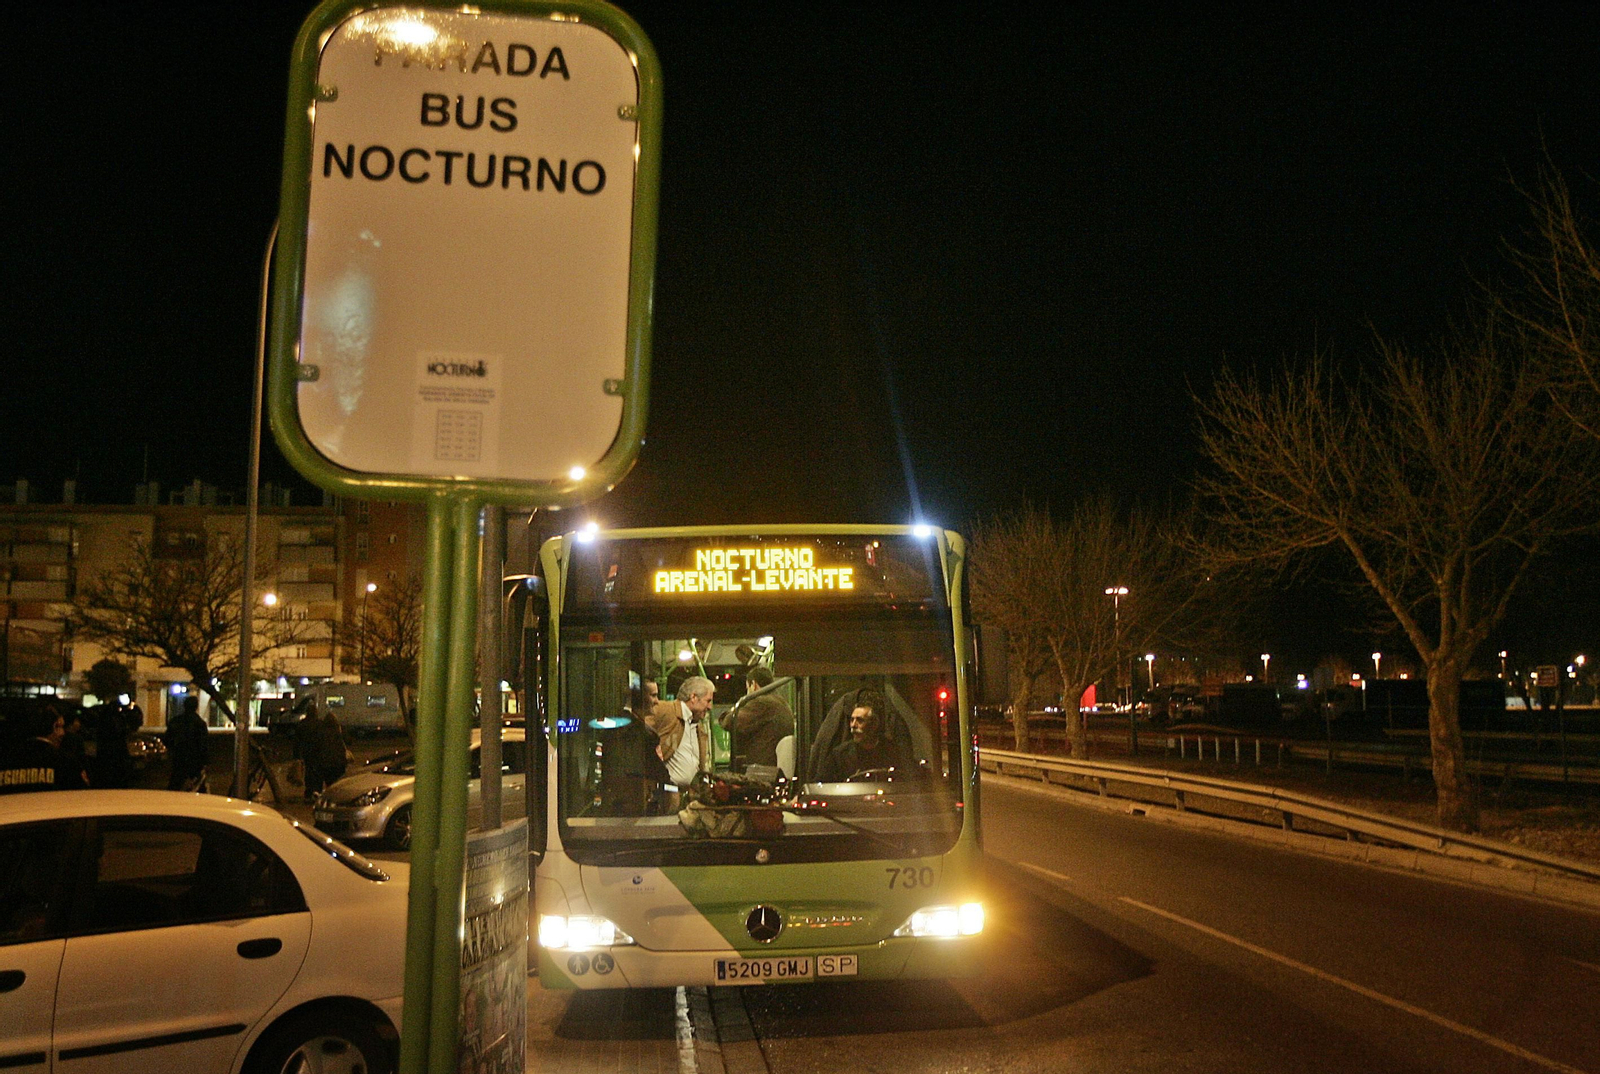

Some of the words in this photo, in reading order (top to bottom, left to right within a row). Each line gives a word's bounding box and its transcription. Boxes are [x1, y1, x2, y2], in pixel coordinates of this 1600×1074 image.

[420, 93, 518, 133] BUS
[323, 143, 607, 195] NOCTURNO
[696, 548, 814, 570] NOCTURNO
[655, 568, 853, 592] ARENAL-LEVANTE
[885, 866, 935, 889] 730
[728, 961, 772, 978] 5209
[777, 960, 809, 976] GMJ
[822, 957, 853, 973] SP
